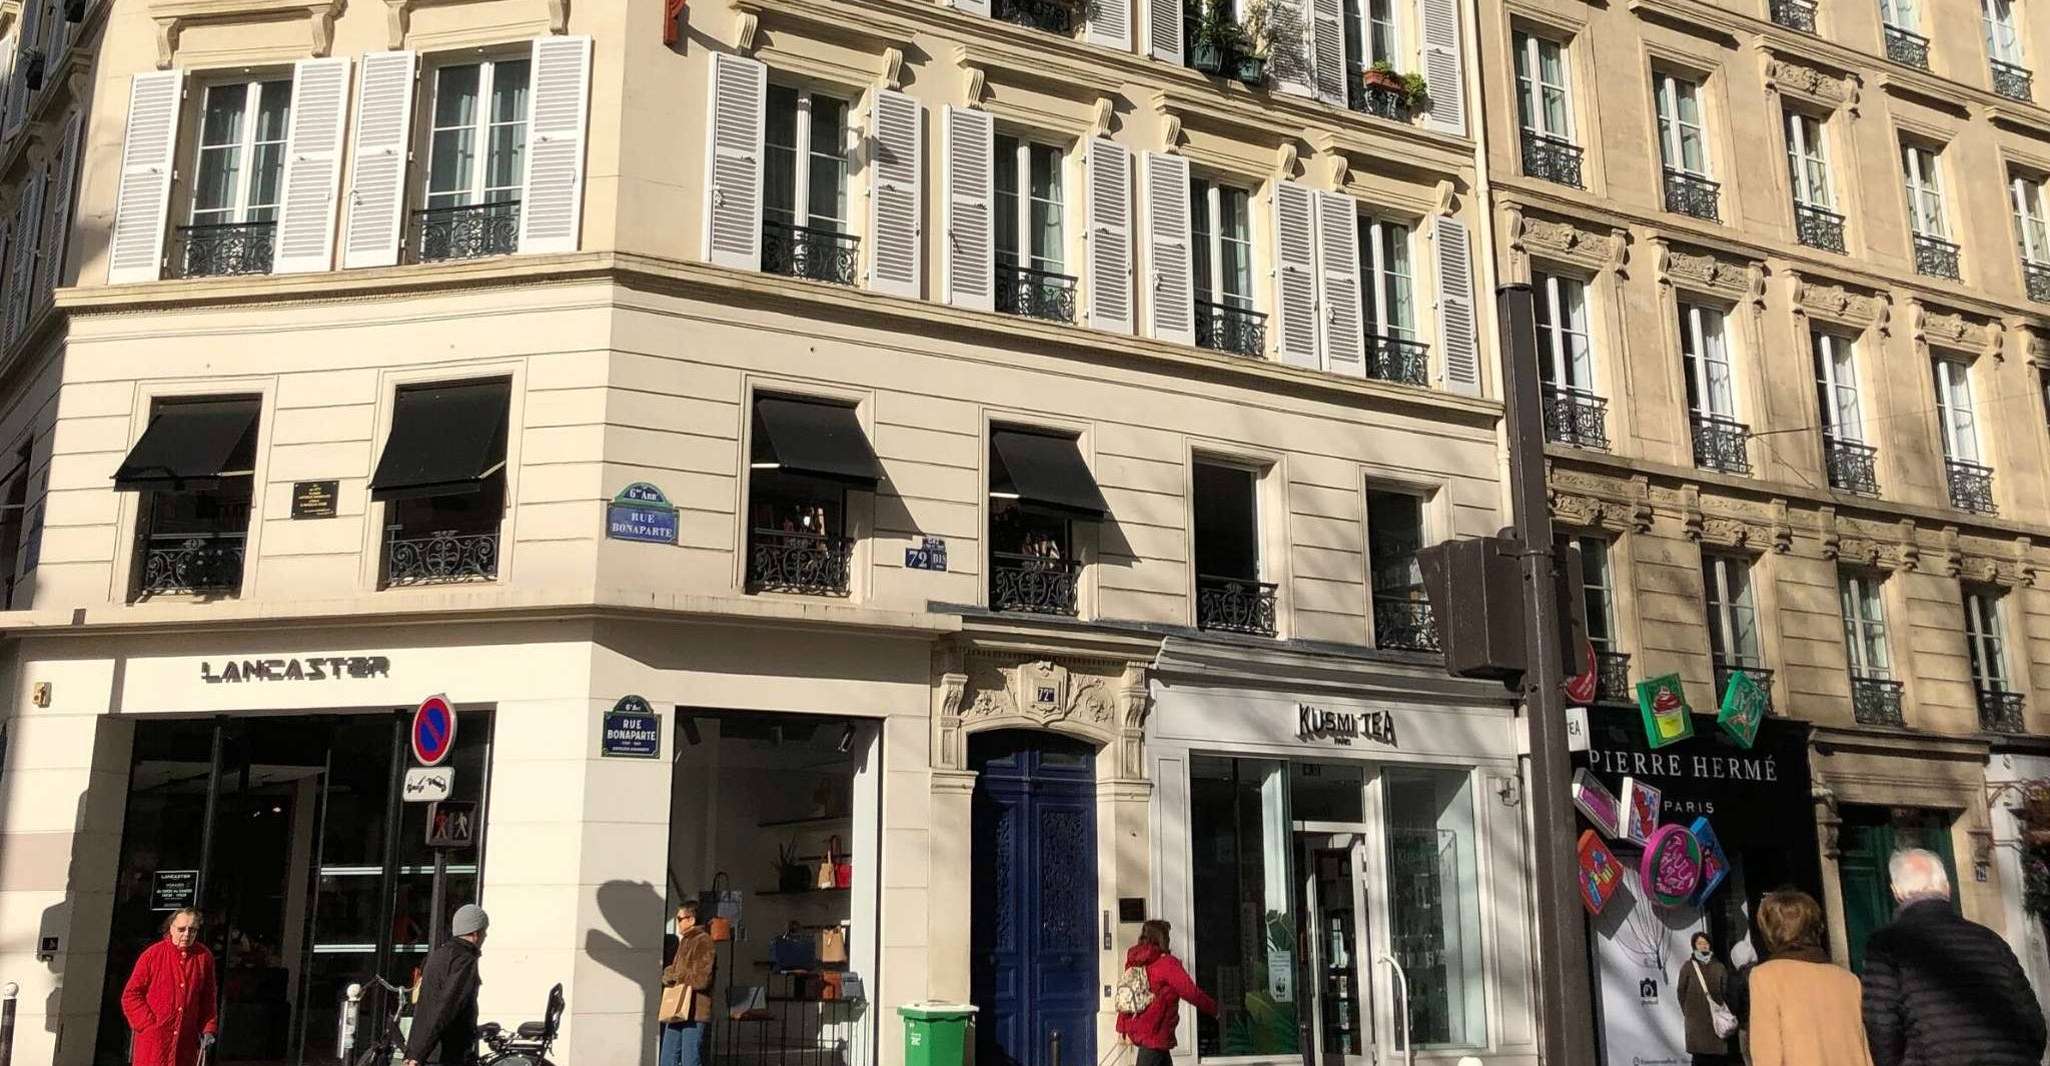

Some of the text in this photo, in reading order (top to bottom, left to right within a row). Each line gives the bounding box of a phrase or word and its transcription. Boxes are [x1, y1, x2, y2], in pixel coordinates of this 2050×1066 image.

[631, 512, 656, 525] RUE
[612, 522, 673, 538] BONAPARTE
[908, 550, 928, 569] 72
[201, 656, 391, 684] LANCASTER
[623, 719, 642, 730] RUE
[1297, 703, 1397, 746] KUSMI TEA
[1567, 720, 1581, 736] EA
[607, 729, 656, 741] BONAPARTE
[1589, 750, 1778, 782] PIERRE HERMÉ
[1664, 800, 1714, 814] PARIS
